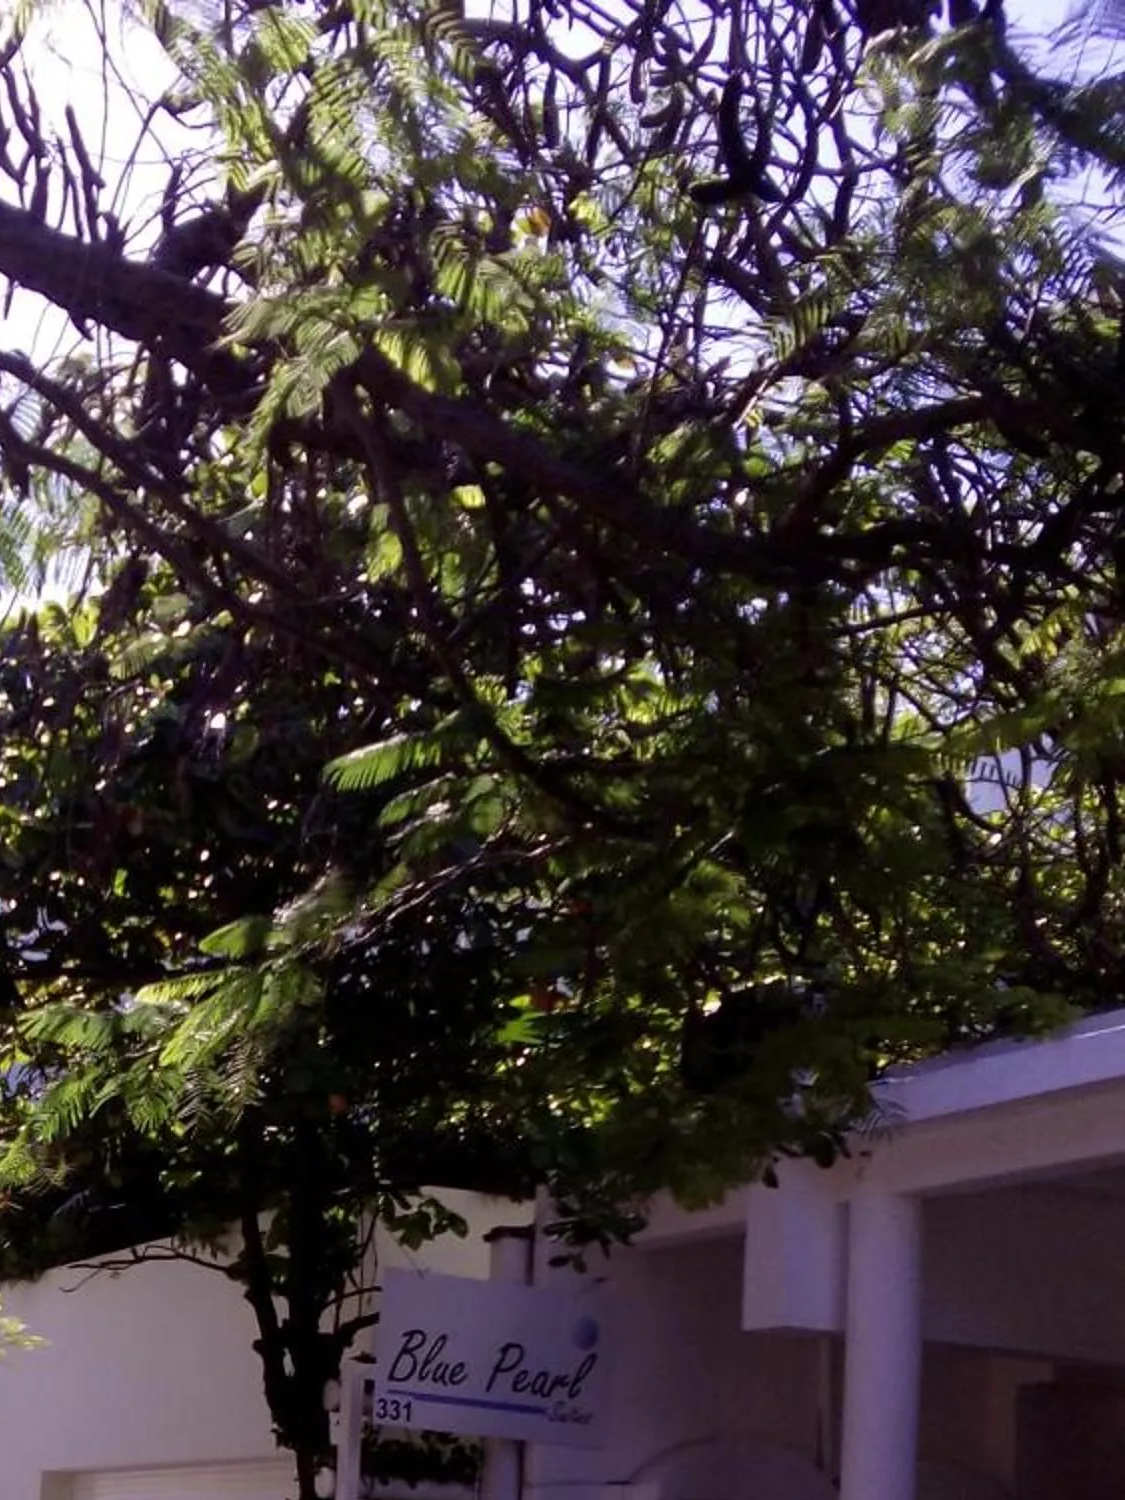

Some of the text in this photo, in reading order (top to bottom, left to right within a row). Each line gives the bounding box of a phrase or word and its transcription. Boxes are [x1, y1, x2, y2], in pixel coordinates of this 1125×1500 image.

[387, 1329, 599, 1400] Blue Pearl
[375, 1398, 413, 1423] 331
